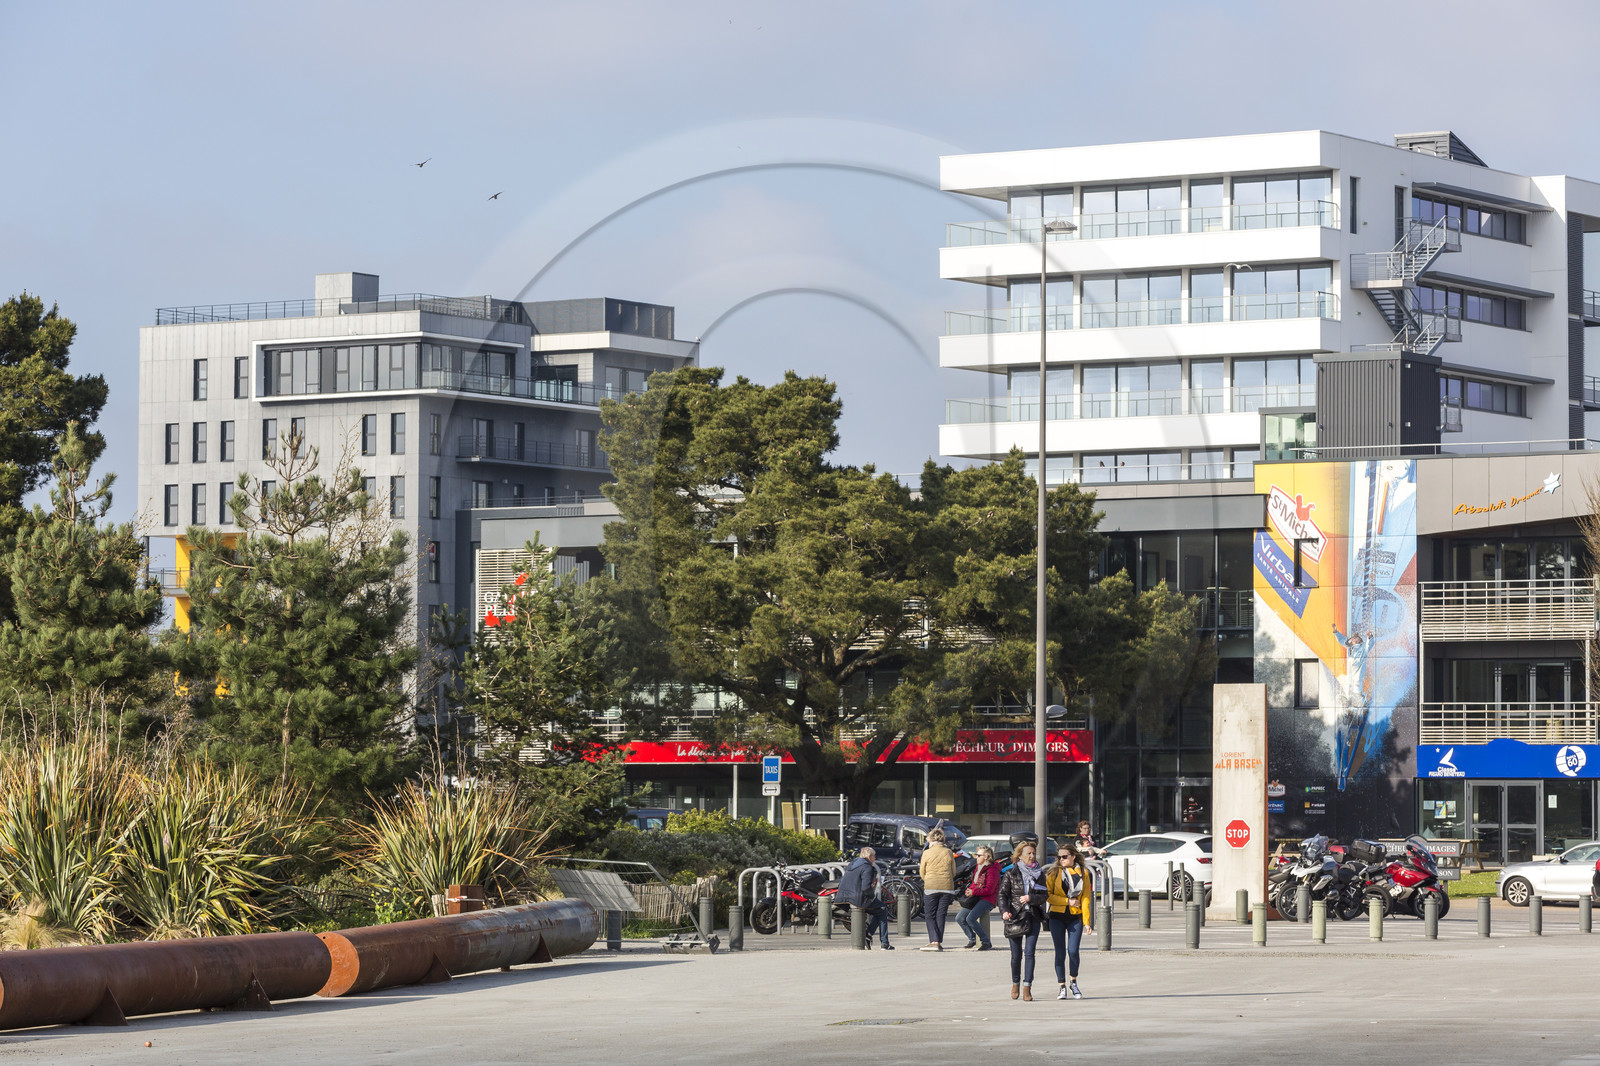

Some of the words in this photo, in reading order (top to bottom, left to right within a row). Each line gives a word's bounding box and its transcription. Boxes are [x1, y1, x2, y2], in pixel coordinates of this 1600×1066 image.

[1453, 500, 1507, 515] Absolute
[1510, 486, 1544, 507] Dreamer
[677, 745, 687, 756] La
[1013, 741, 1069, 753] D'IMGES
[1567, 757, 1578, 767] 60
[765, 765, 778, 774] TAXIS
[1226, 828, 1249, 839] STOP
